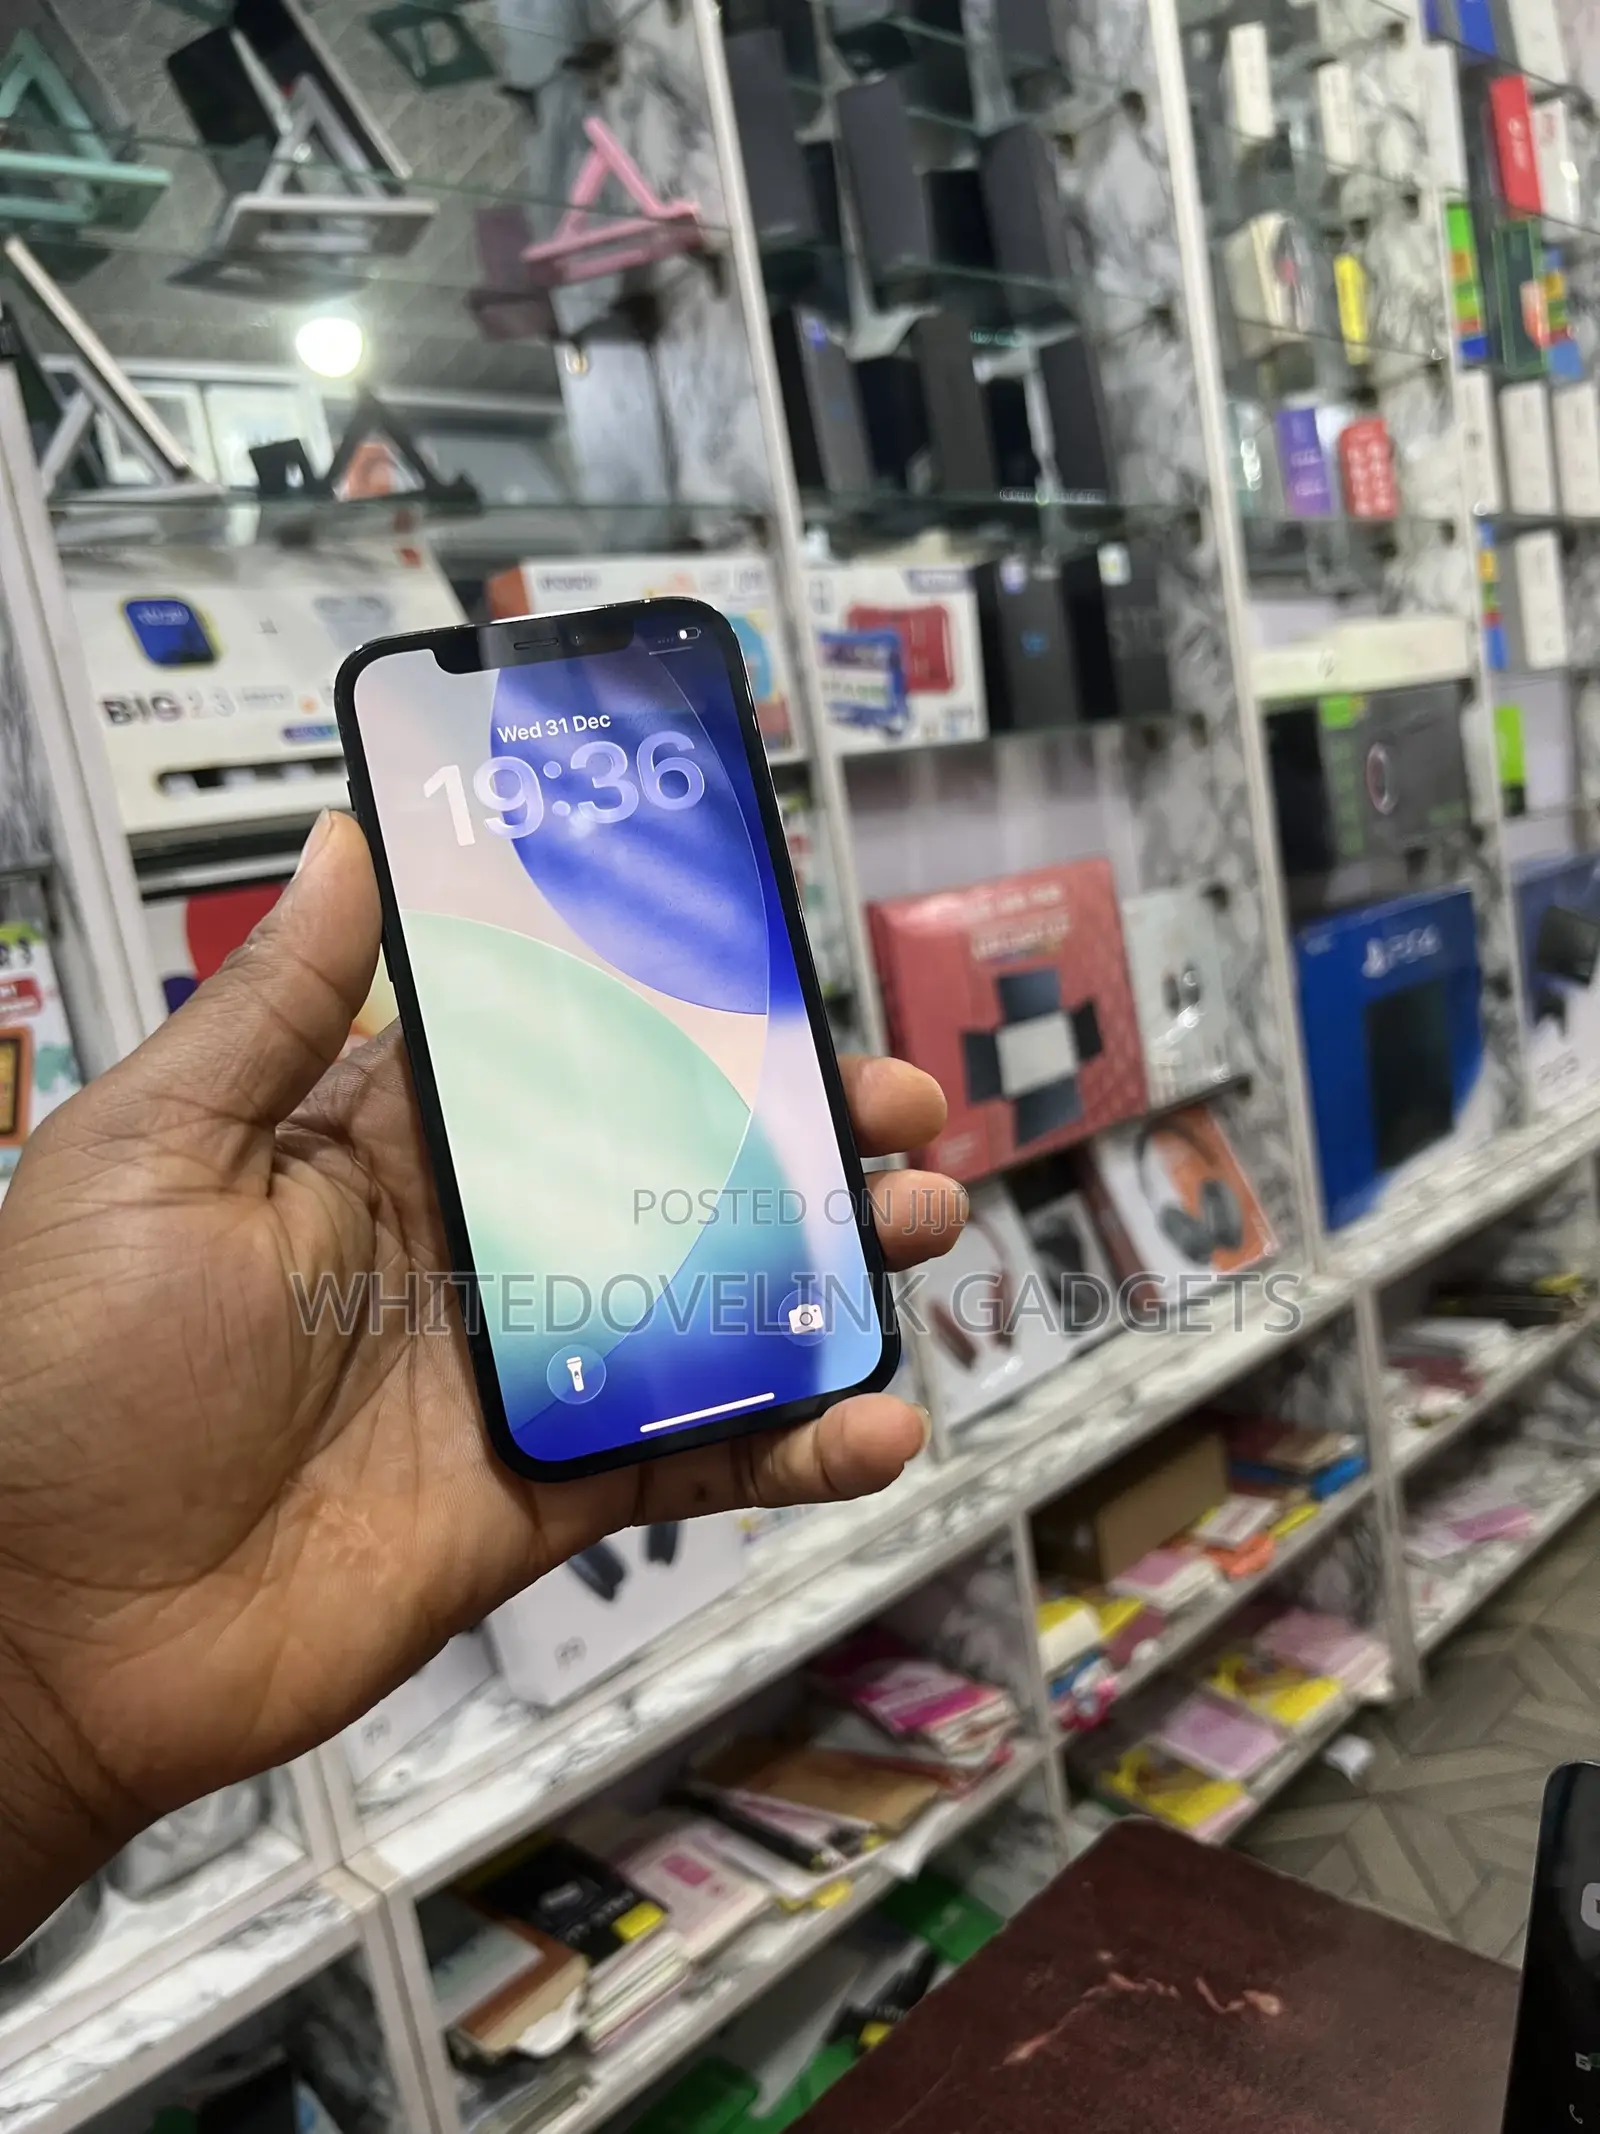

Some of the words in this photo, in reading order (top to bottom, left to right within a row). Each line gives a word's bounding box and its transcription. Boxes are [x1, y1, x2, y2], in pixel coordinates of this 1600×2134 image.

[497, 721, 542, 743] Wed
[546, 717, 570, 737] 31
[573, 714, 612, 732] Dec
[423, 731, 705, 846] 19:36
